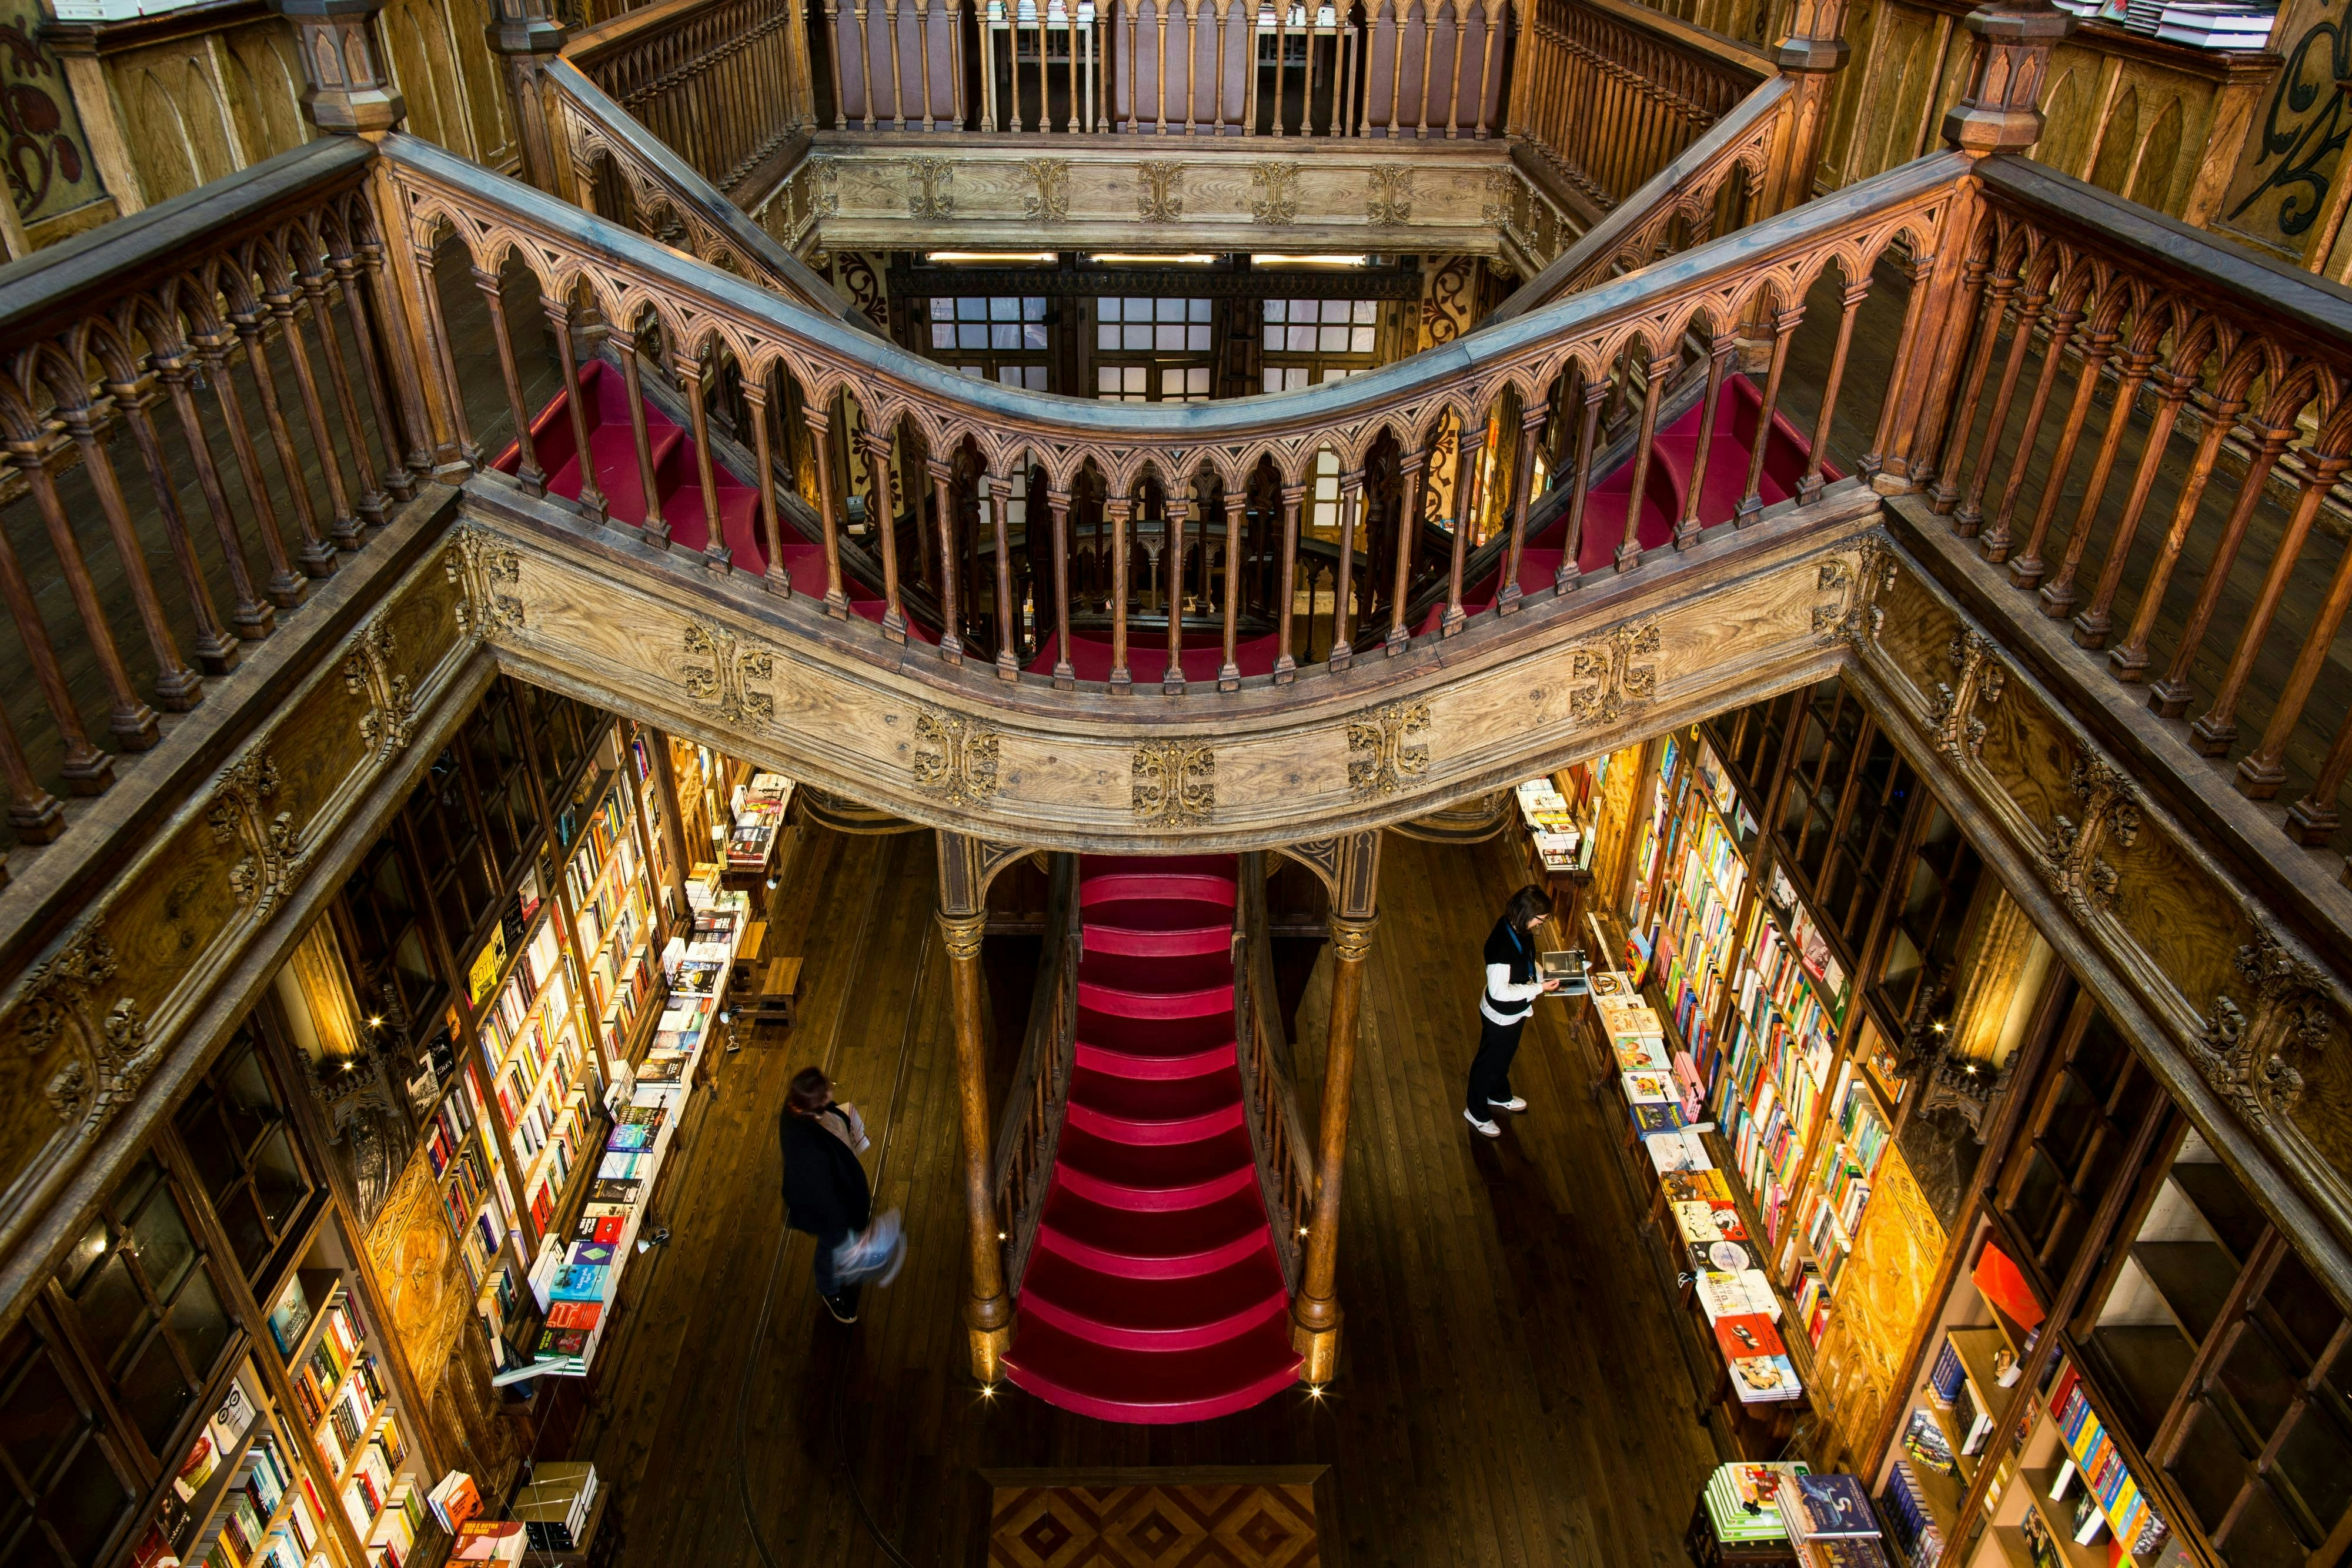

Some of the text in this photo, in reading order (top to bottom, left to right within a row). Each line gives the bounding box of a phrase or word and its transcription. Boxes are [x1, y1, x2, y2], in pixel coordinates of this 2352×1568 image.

[437, 1061, 453, 1076] GREY
[626, 1106, 636, 1124] EDONDO
[287, 1309, 306, 1339] FORMAN
[288, 1307, 303, 1330] GAYLE
[227, 1407, 241, 1426] SUCESSO
